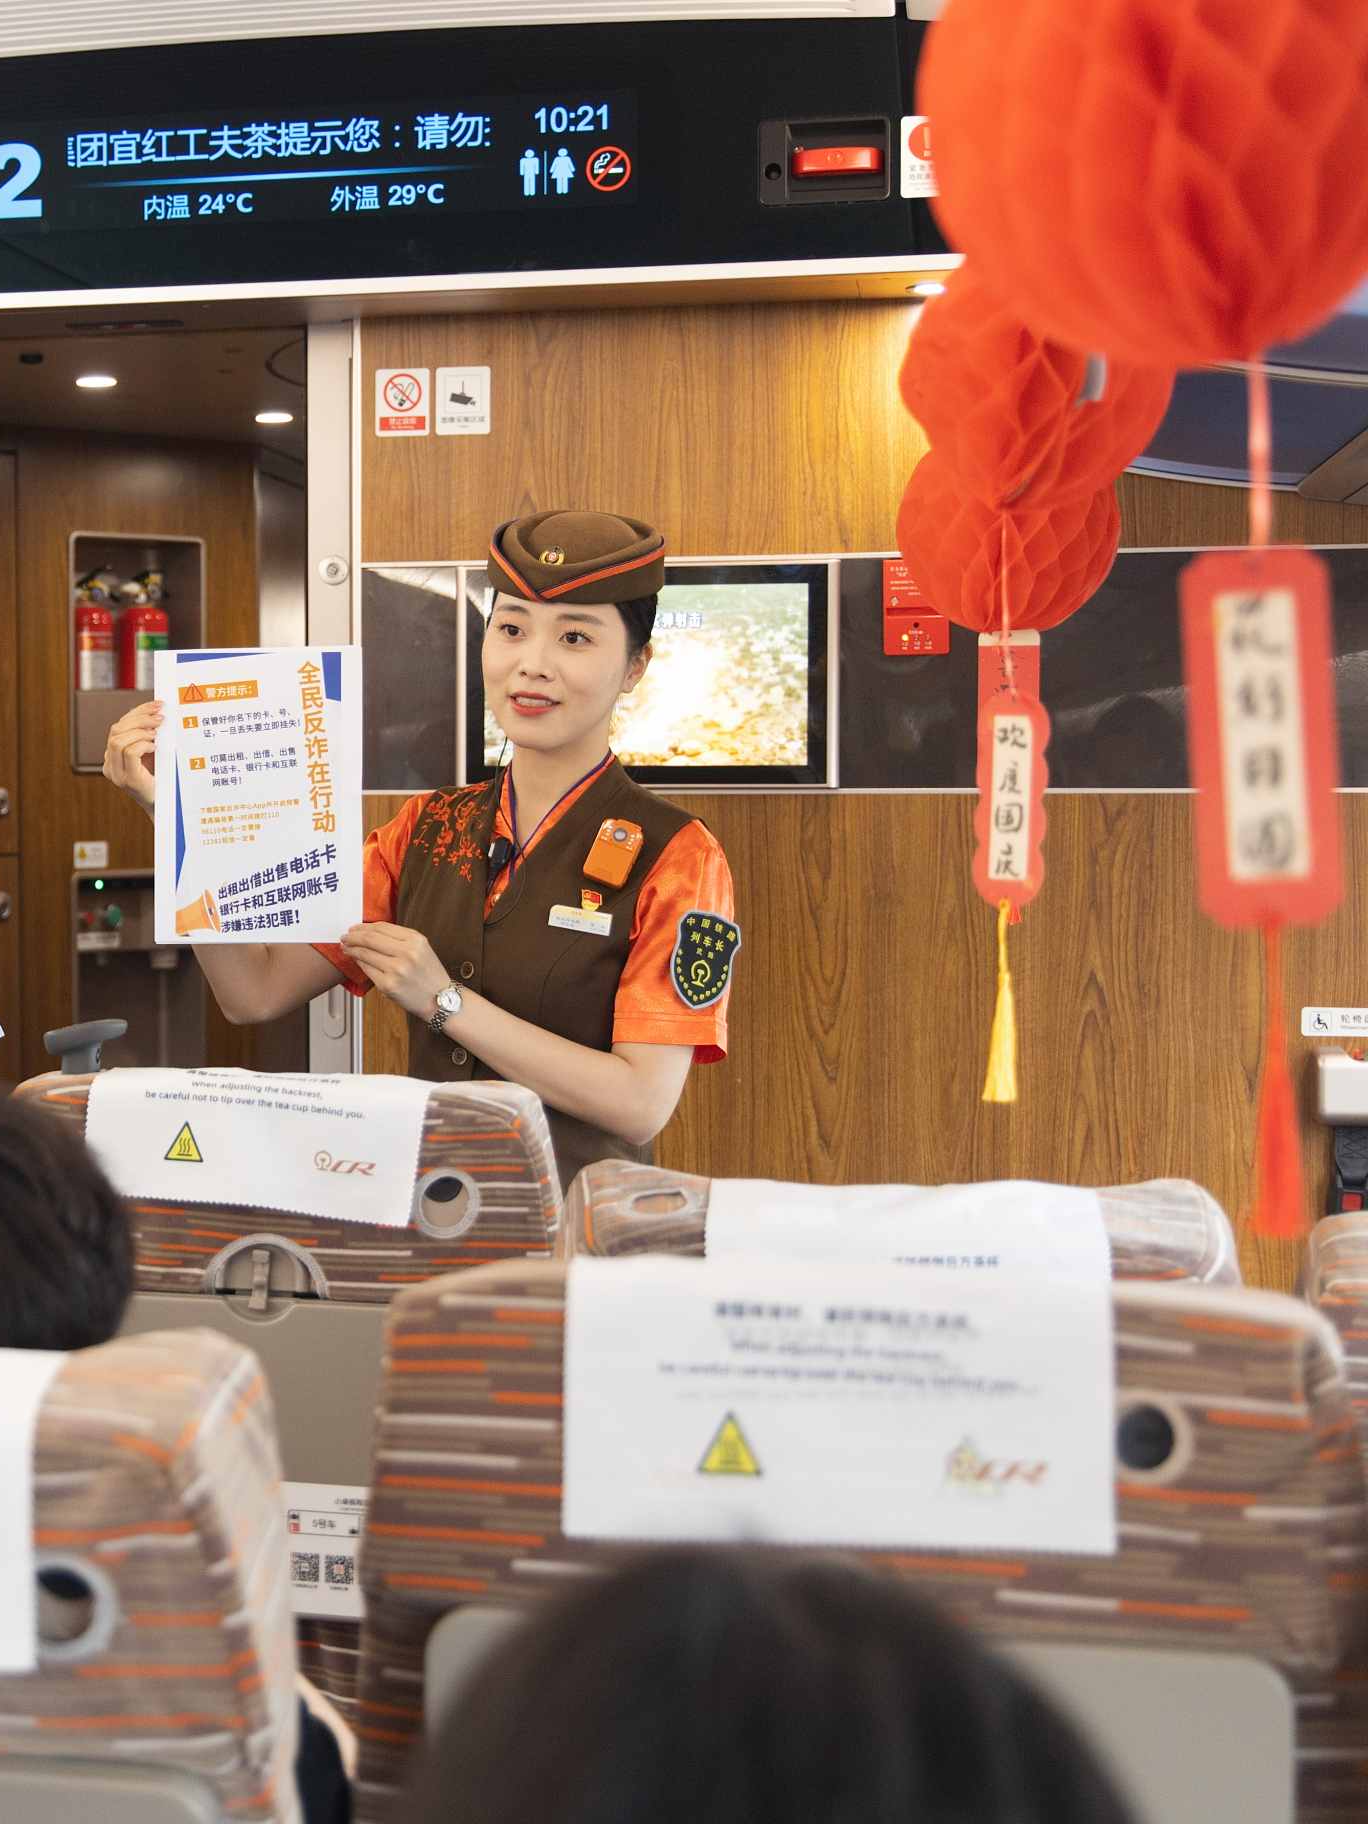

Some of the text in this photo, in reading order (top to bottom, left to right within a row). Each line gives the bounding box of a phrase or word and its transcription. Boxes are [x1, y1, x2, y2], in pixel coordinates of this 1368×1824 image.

[535, 104, 609, 134] 10:21
[67, 112, 491, 168] 团宜红工夫茶提示您：请勿
[143, 192, 253, 221] 内温 24°C
[331, 183, 445, 212] 外温 29°C
[297, 661, 336, 832] 全民反诈在行动
[218, 843, 336, 900] 出租出借出售电话卡
[219, 872, 339, 916] 银行卡和互联网账号
[221, 909, 300, 934] 涉嫌违法犯罪！
[686, 916, 736, 942] 中国铁路
[690, 931, 724, 952] 列车长
[191, 1080, 217, 1089] When
[220, 1082, 262, 1094] adjusting
[264, 1085, 280, 1094] the
[145, 1090, 157, 1099] be
[158, 1090, 191, 1101] careful
[192, 1093, 208, 1102] not
[209, 1094, 219, 1103] to
[220, 1094, 234, 1105] tip
[235, 1097, 256, 1106] over
[258, 1098, 273, 1108] the
[275, 1100, 290, 1110] tea
[292, 1103, 309, 1113] cup
[310, 1103, 344, 1117] behind
